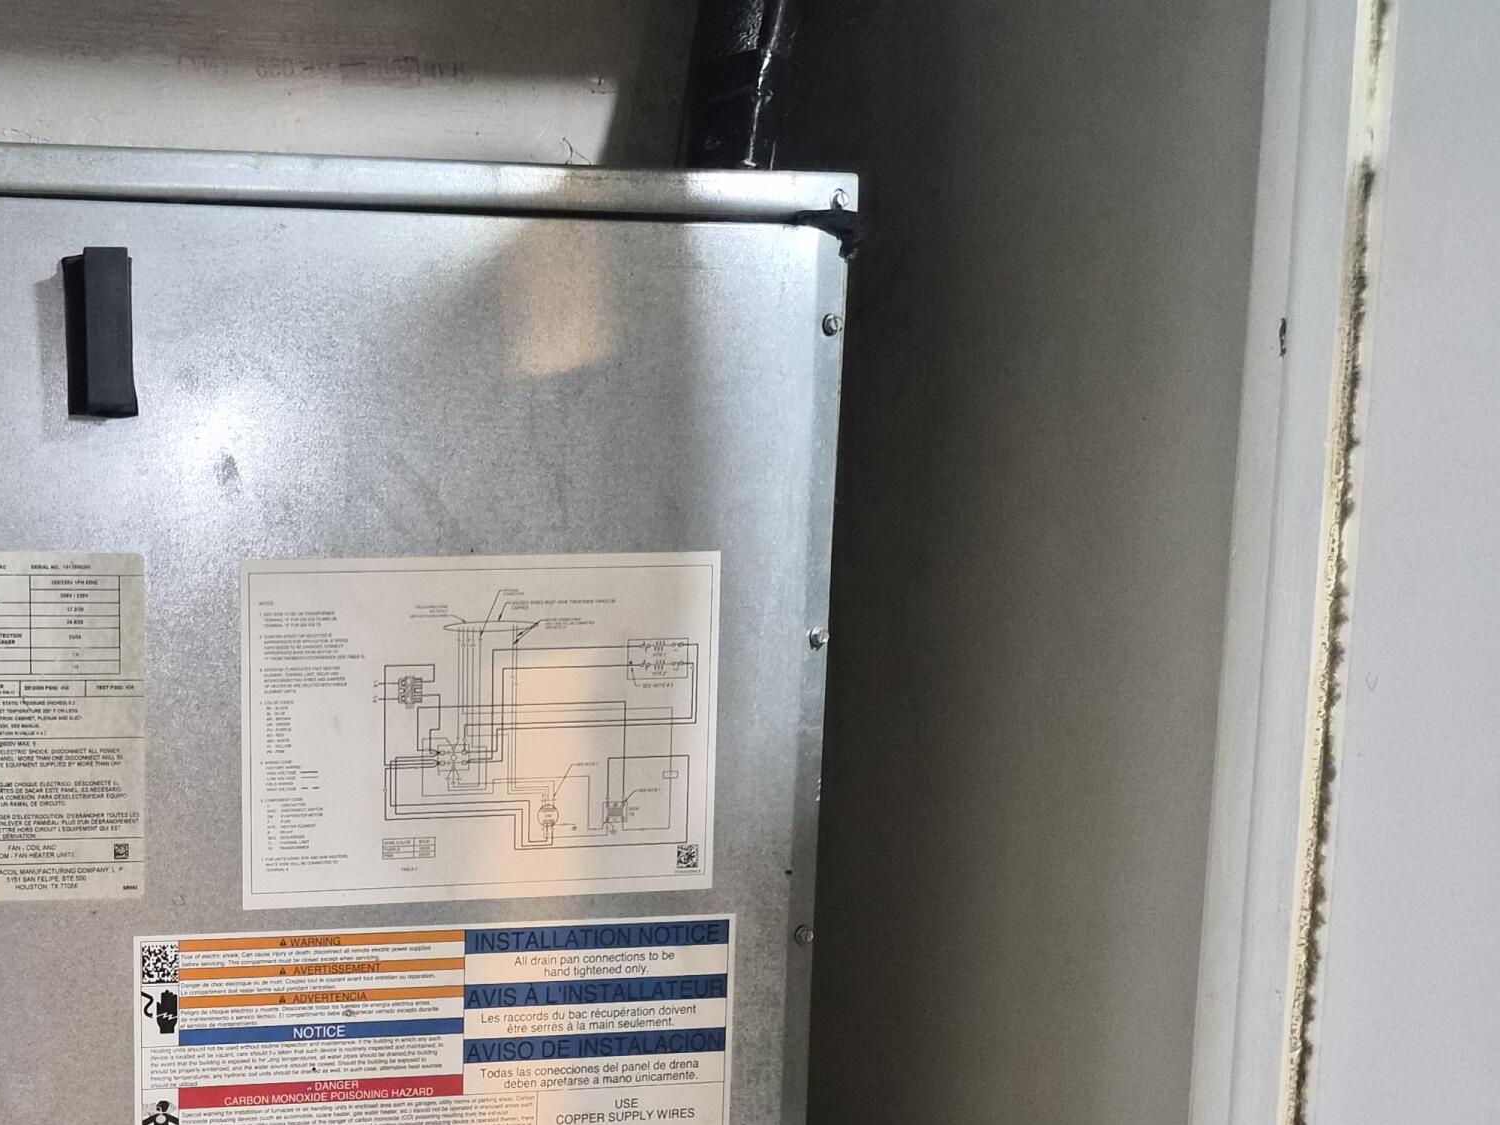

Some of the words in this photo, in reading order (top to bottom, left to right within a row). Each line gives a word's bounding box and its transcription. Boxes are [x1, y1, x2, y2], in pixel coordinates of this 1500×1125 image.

[290, 936, 341, 947] WARNING
[475, 928, 630, 951] INSTALLATION
[639, 924, 719, 945] NOTICE
[514, 956, 526, 966] All
[530, 955, 557, 965] drain
[560, 954, 579, 966] pan
[583, 951, 645, 963] connections
[648, 951, 658, 961] to
[662, 950, 675, 960] be
[293, 962, 381, 975] AVERTISSEMENT
[544, 967, 570, 977] hand
[574, 965, 622, 978] tightened
[625, 964, 649, 976] only.
[293, 991, 366, 1003] ADVERTENCIA
[468, 987, 516, 1006] AVIS
[546, 979, 724, 1003] L'INSTALLATEUR
[481, 1013, 500, 1023] Les
[504, 1011, 549, 1022] raccords
[552, 1010, 565, 1020] du
[569, 1009, 587, 1019] bac
[591, 1007, 655, 1021] récupération
[658, 1005, 696, 1016] doivent
[567, 1021, 573, 1030] à
[577, 1020, 586, 1030] la
[589, 1019, 614, 1029] main
[618, 1017, 674, 1028] seulement.
[293, 1025, 345, 1038] NOTICE
[467, 1040, 534, 1061] AVISO
[542, 1039, 570, 1057] DE
[480, 1067, 513, 1079] Todas
[517, 1066, 531, 1077] las
[535, 1063, 599, 1076] conecciones
[603, 1062, 618, 1073] del
[622, 1061, 650, 1074] panel
[653, 1060, 666, 1070] de
[669, 1059, 699, 1070] drena
[315, 1080, 359, 1091] DANGER
[504, 1078, 537, 1089] deben
[540, 1075, 589, 1089] apretarse
[603, 1076, 632, 1084] mano
[224, 1095, 269, 1105] CARBON
[272, 1092, 327, 1103] MONOXIDE
[330, 1089, 389, 1101] POISONING
[391, 1087, 433, 1098] HAZARD
[615, 1098, 638, 1109] USE
[556, 1113, 605, 1125] COPPER
[608, 1110, 654, 1122] SUPPLY
[656, 1108, 695, 1120] WIRES
